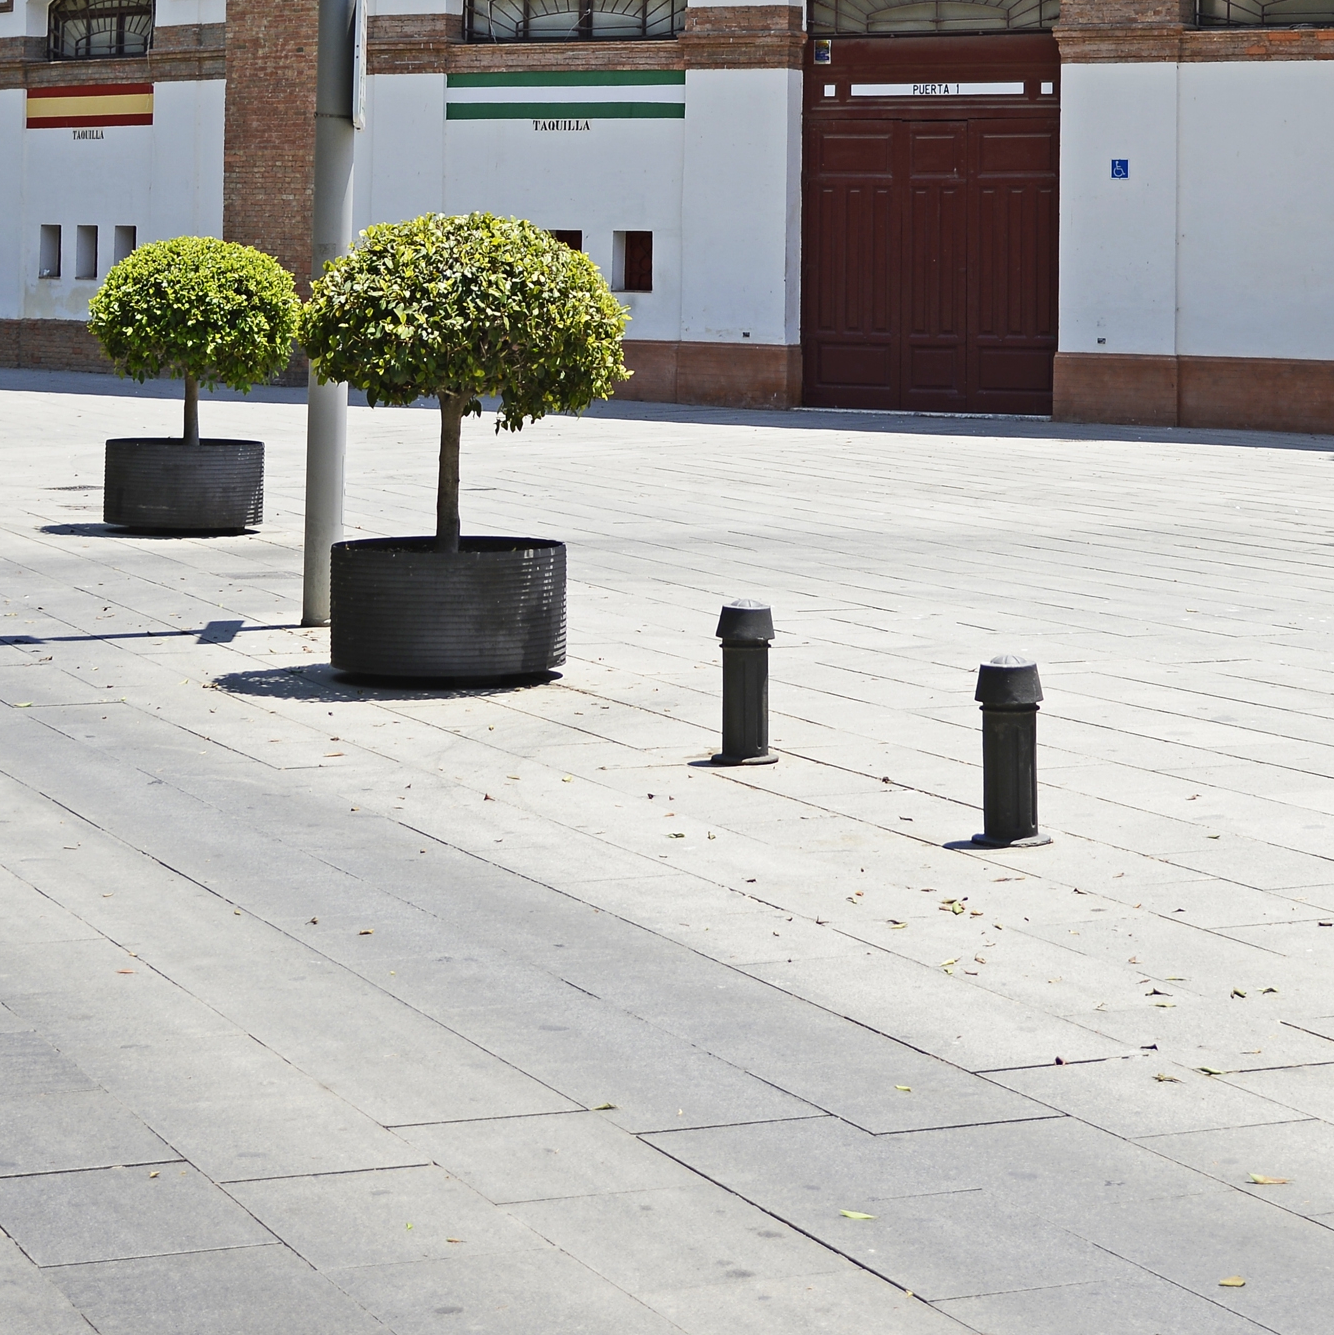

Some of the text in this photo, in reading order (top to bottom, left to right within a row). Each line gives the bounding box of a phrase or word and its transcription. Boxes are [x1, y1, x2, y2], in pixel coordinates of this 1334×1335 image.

[912, 83, 960, 95] PUERTA 1
[532, 119, 591, 131] TAQUILLA
